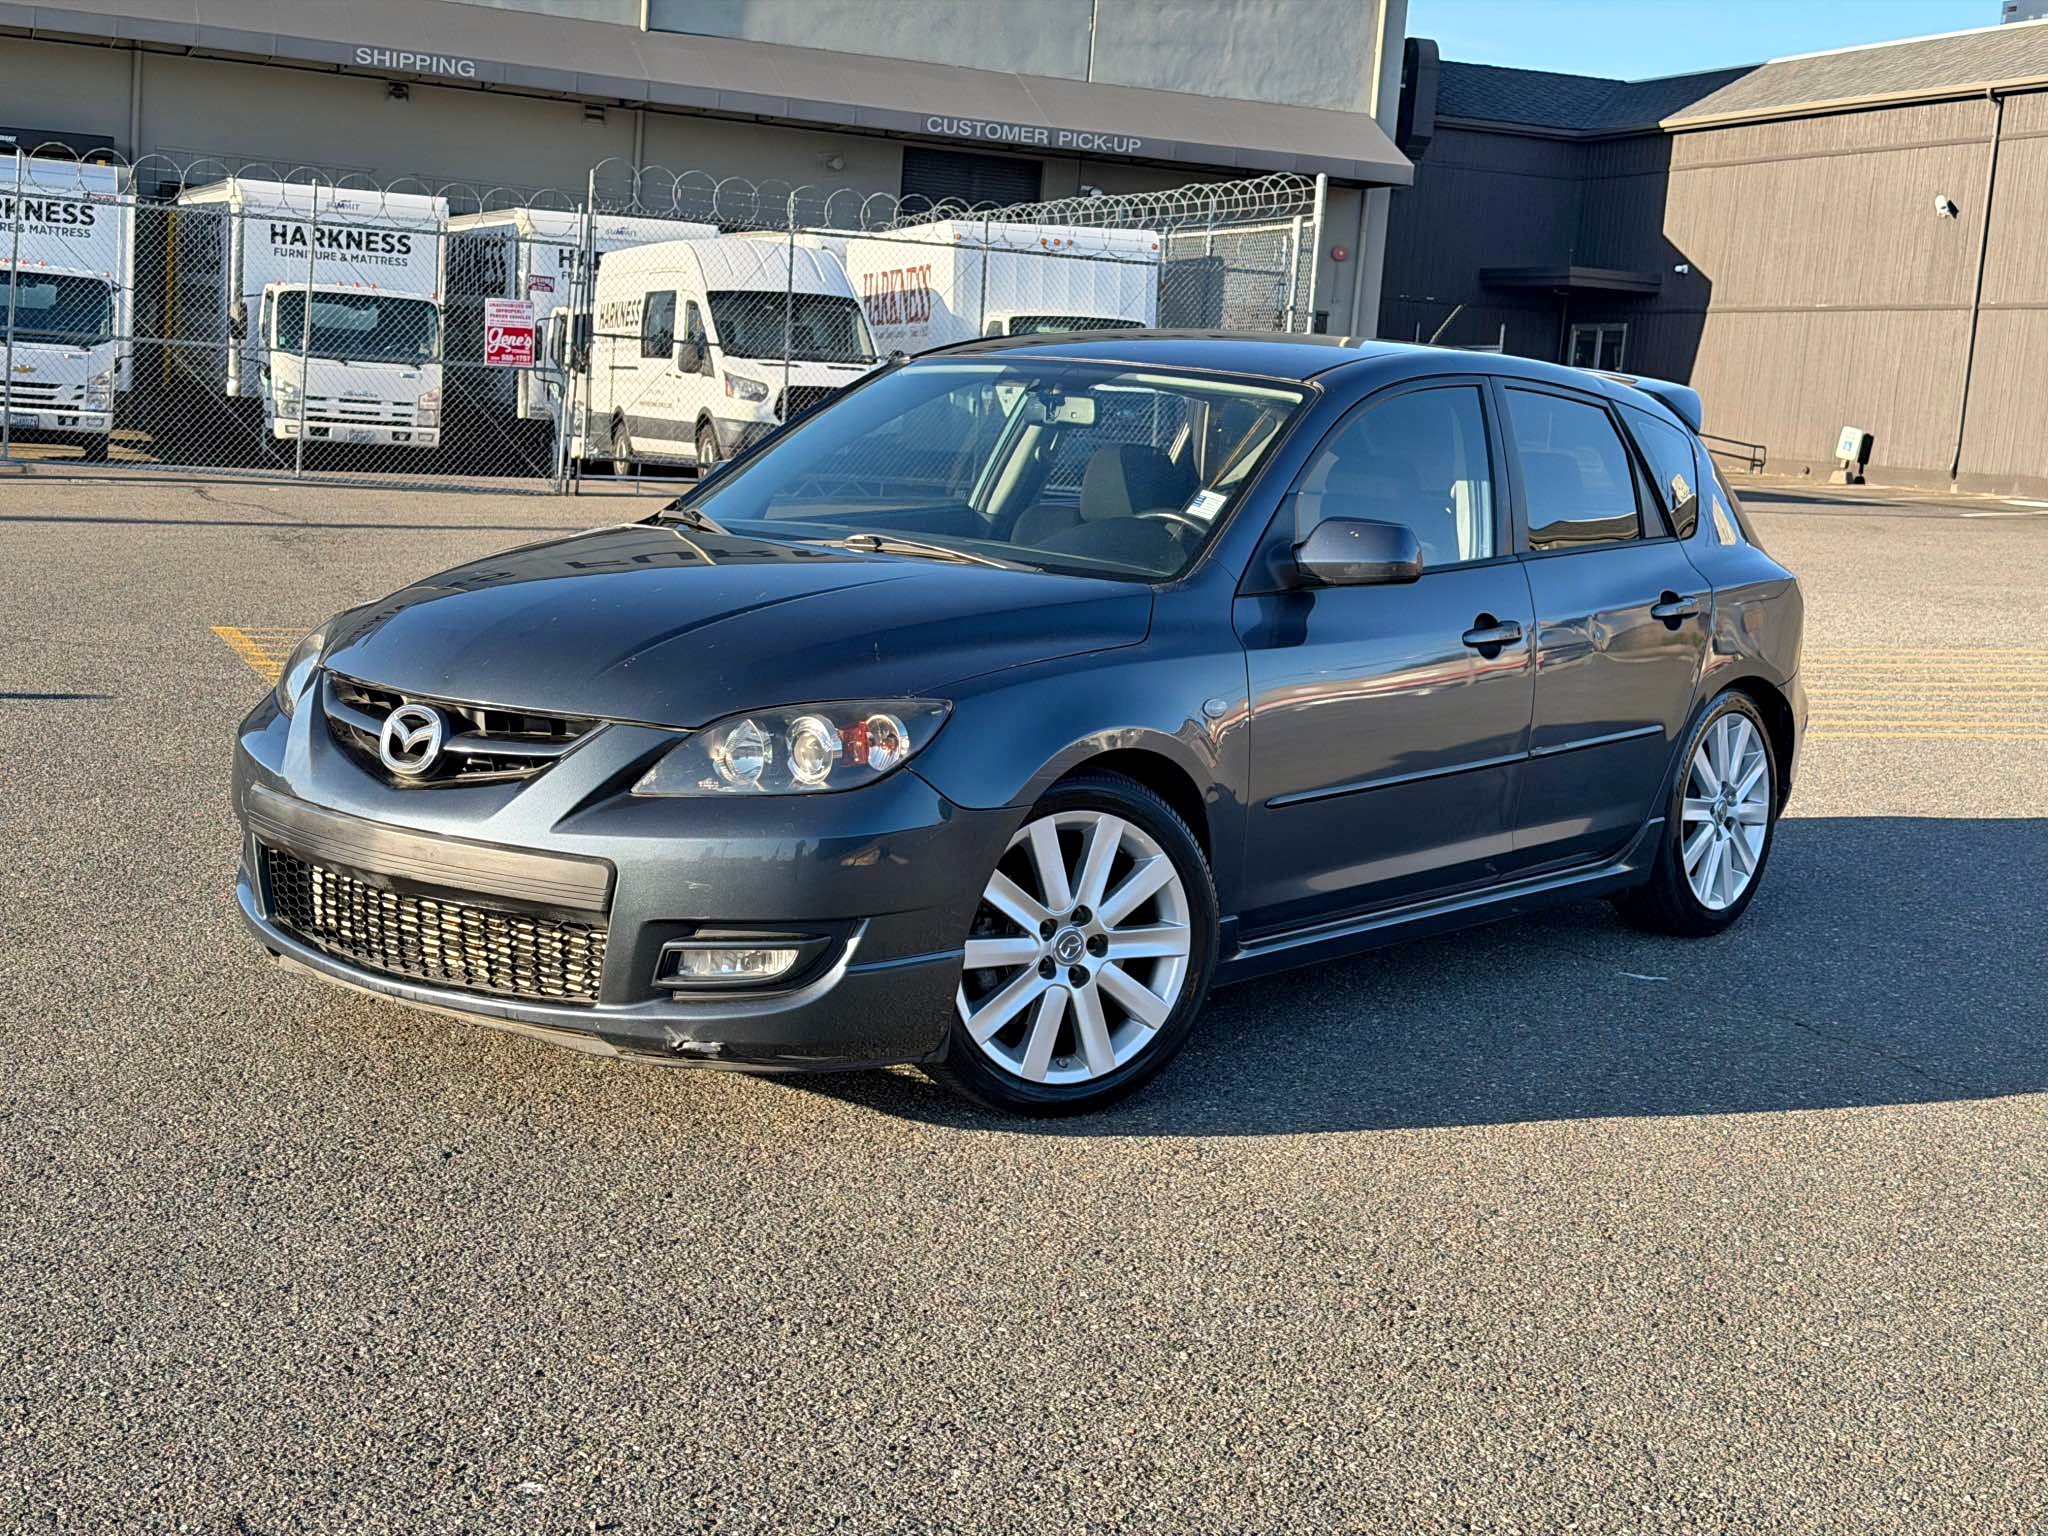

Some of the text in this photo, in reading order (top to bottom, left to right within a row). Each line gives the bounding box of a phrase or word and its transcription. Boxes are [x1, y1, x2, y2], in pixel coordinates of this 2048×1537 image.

[355, 47, 476, 77] SHIPPING
[926, 116, 1142, 153] CUSTOMER PICK-UP
[0, 198, 95, 226] KNESS
[29, 224, 91, 238] MATTRESS
[270, 223, 412, 255] HARKNESS
[273, 247, 408, 267] FURNIURE & MATTRESS
[863, 264, 931, 326] HARKNESS
[599, 299, 641, 329] HARKNESS
